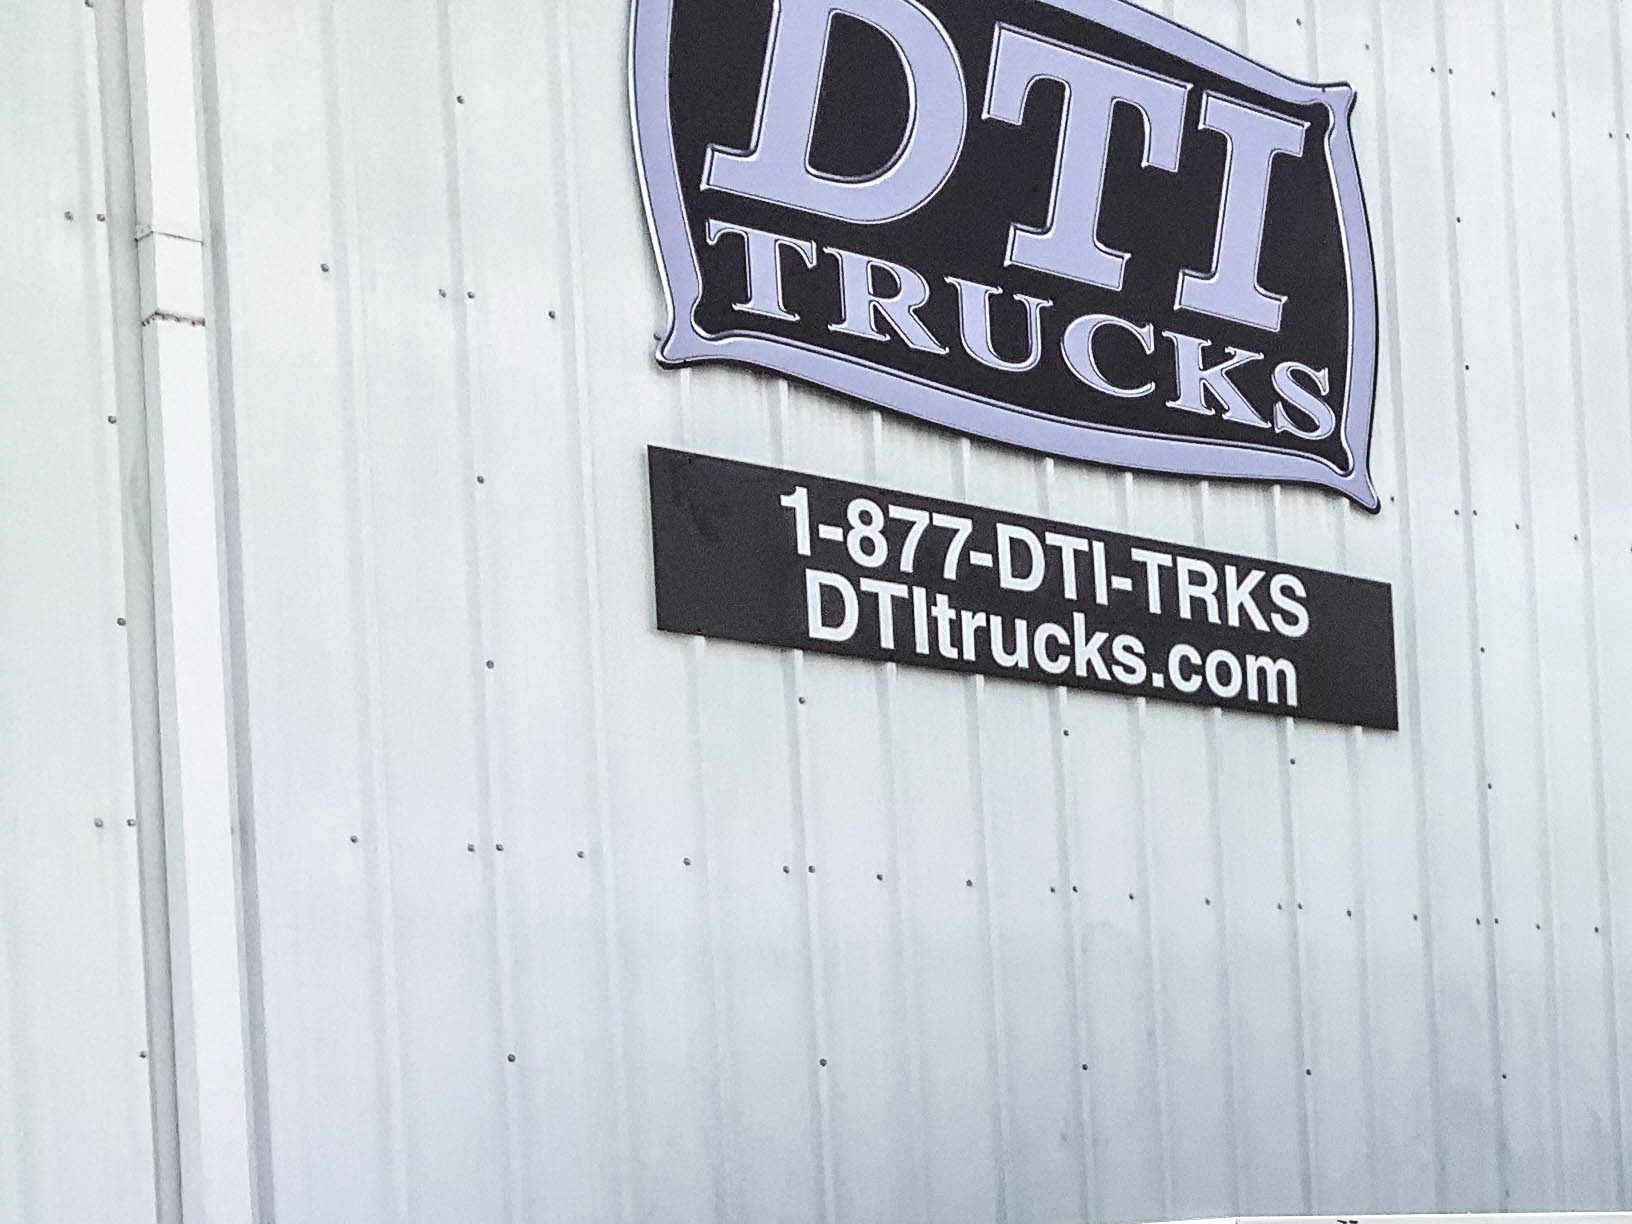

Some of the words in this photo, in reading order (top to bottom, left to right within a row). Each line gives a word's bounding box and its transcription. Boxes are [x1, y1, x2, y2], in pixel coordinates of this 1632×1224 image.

[700, 0, 1312, 332] DTI
[705, 218, 1337, 441] TRUCKS
[780, 486, 1311, 639] 1-877-DTI-TRKS
[803, 567, 1299, 708] DTItrucks.com
